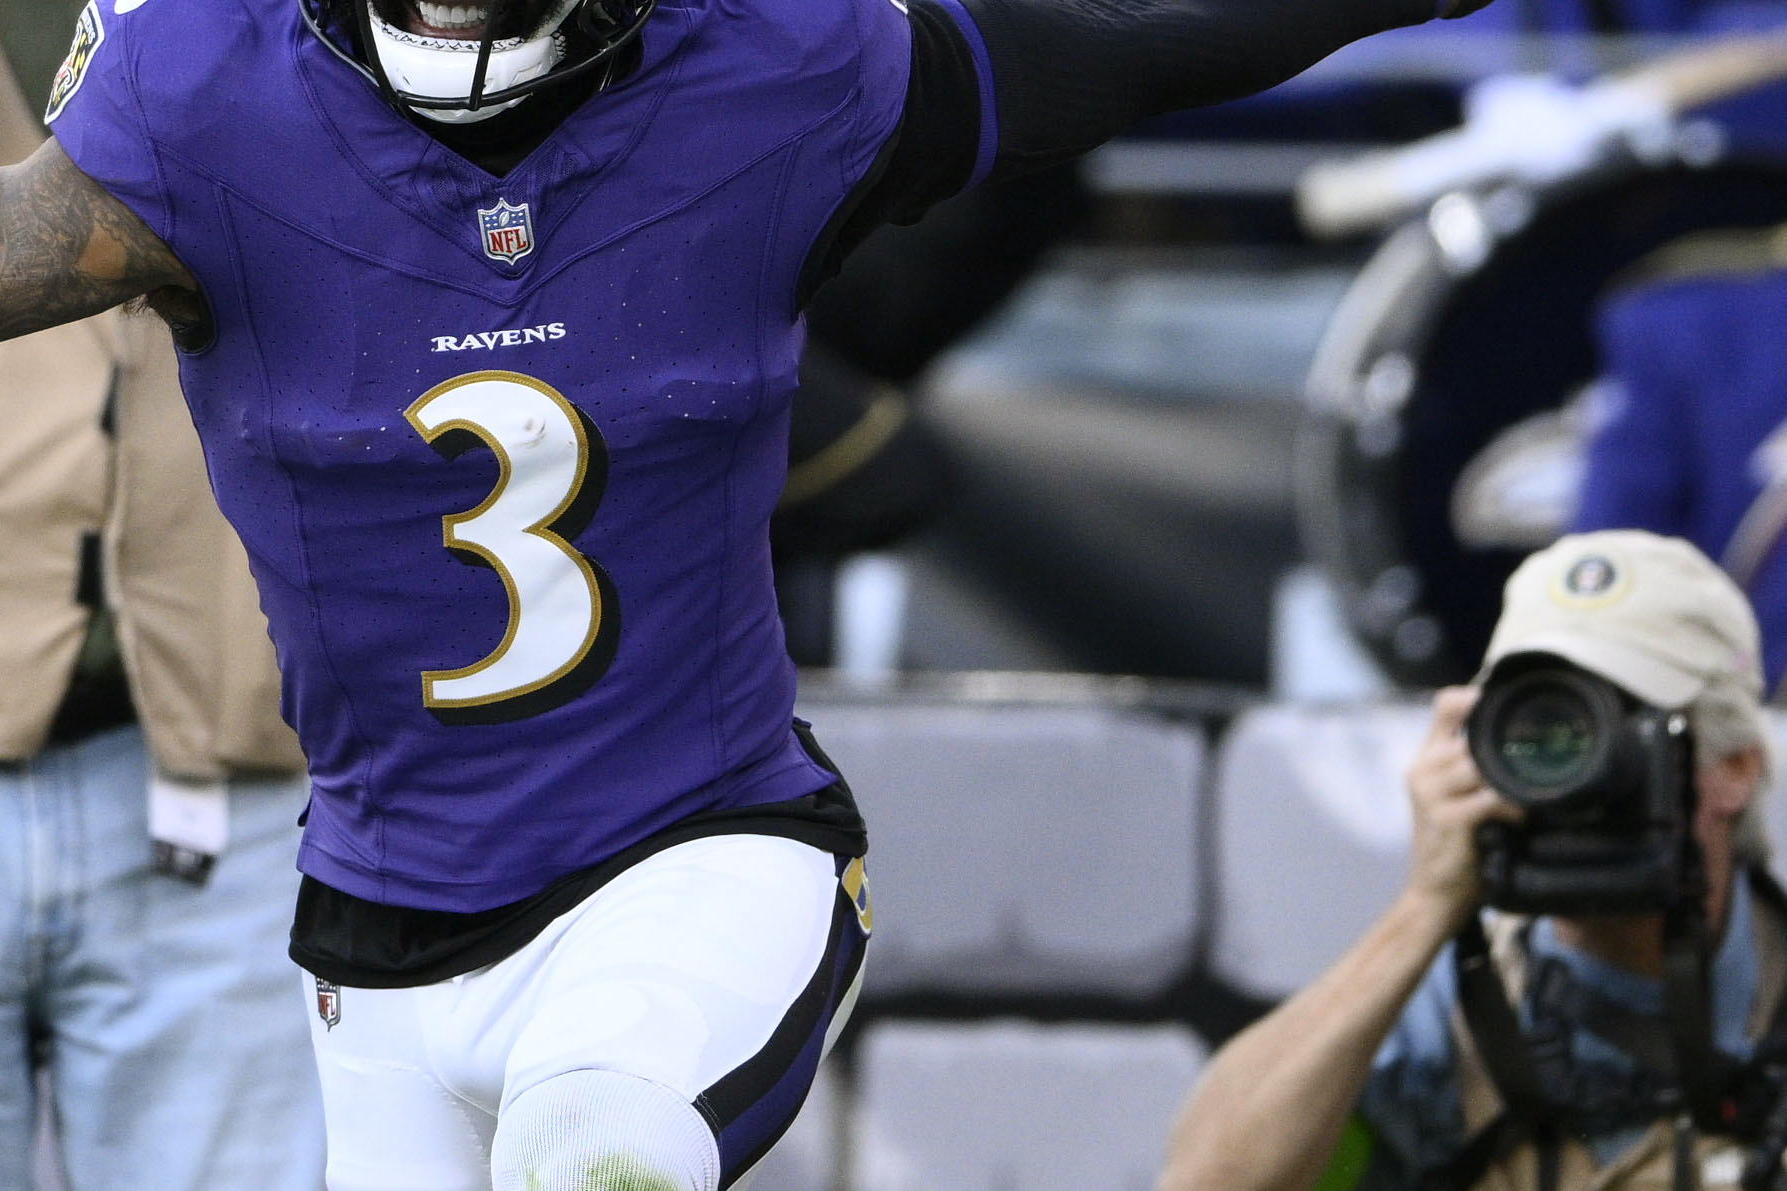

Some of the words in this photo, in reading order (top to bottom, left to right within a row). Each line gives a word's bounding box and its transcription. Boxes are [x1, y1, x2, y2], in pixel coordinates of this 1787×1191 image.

[489, 228, 527, 254] NFL
[430, 321, 567, 352] RAVENS
[403, 369, 622, 726] 3
